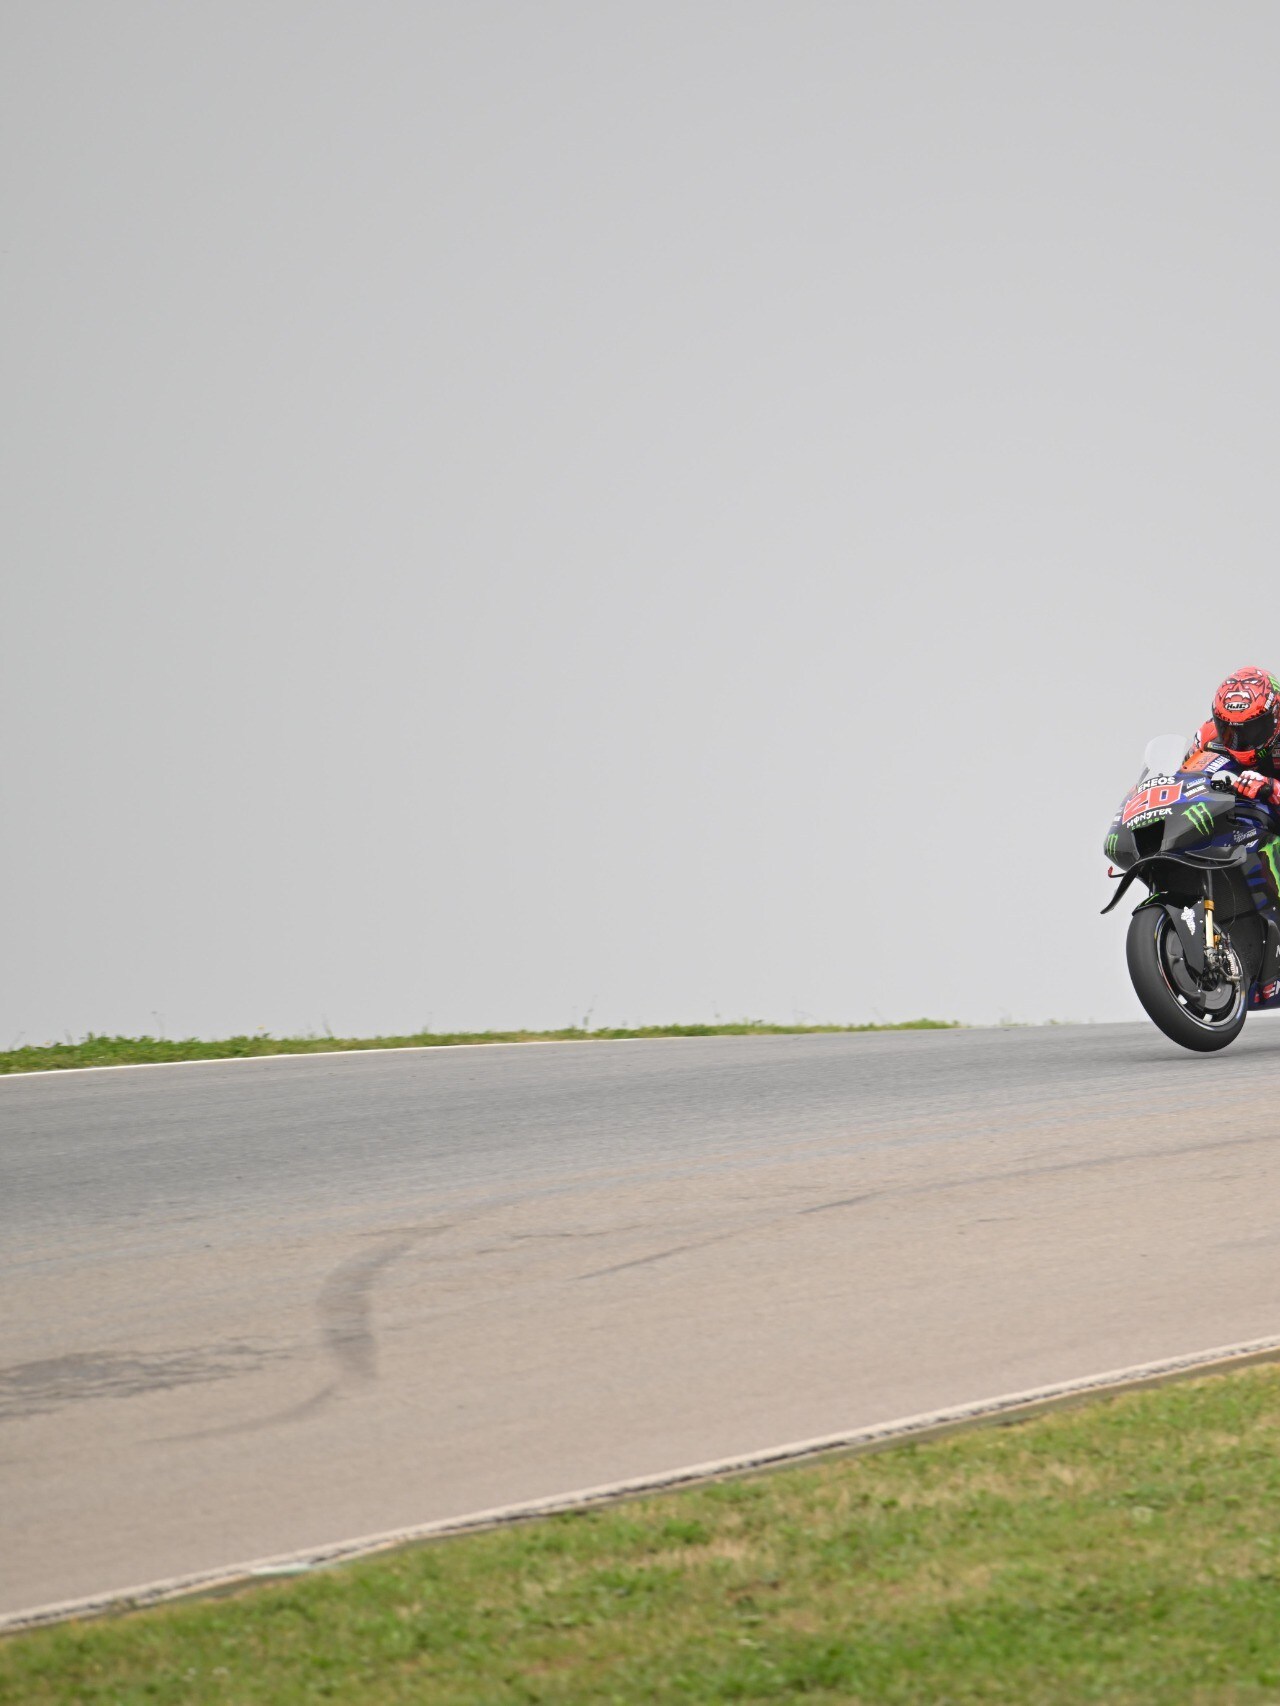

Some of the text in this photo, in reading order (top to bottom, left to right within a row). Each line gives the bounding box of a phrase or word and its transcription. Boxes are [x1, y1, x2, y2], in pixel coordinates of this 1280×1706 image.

[1137, 776, 1176, 794] ENEOS
[1121, 779, 1185, 826] 20
[1126, 807, 1173, 829] MONSTER
